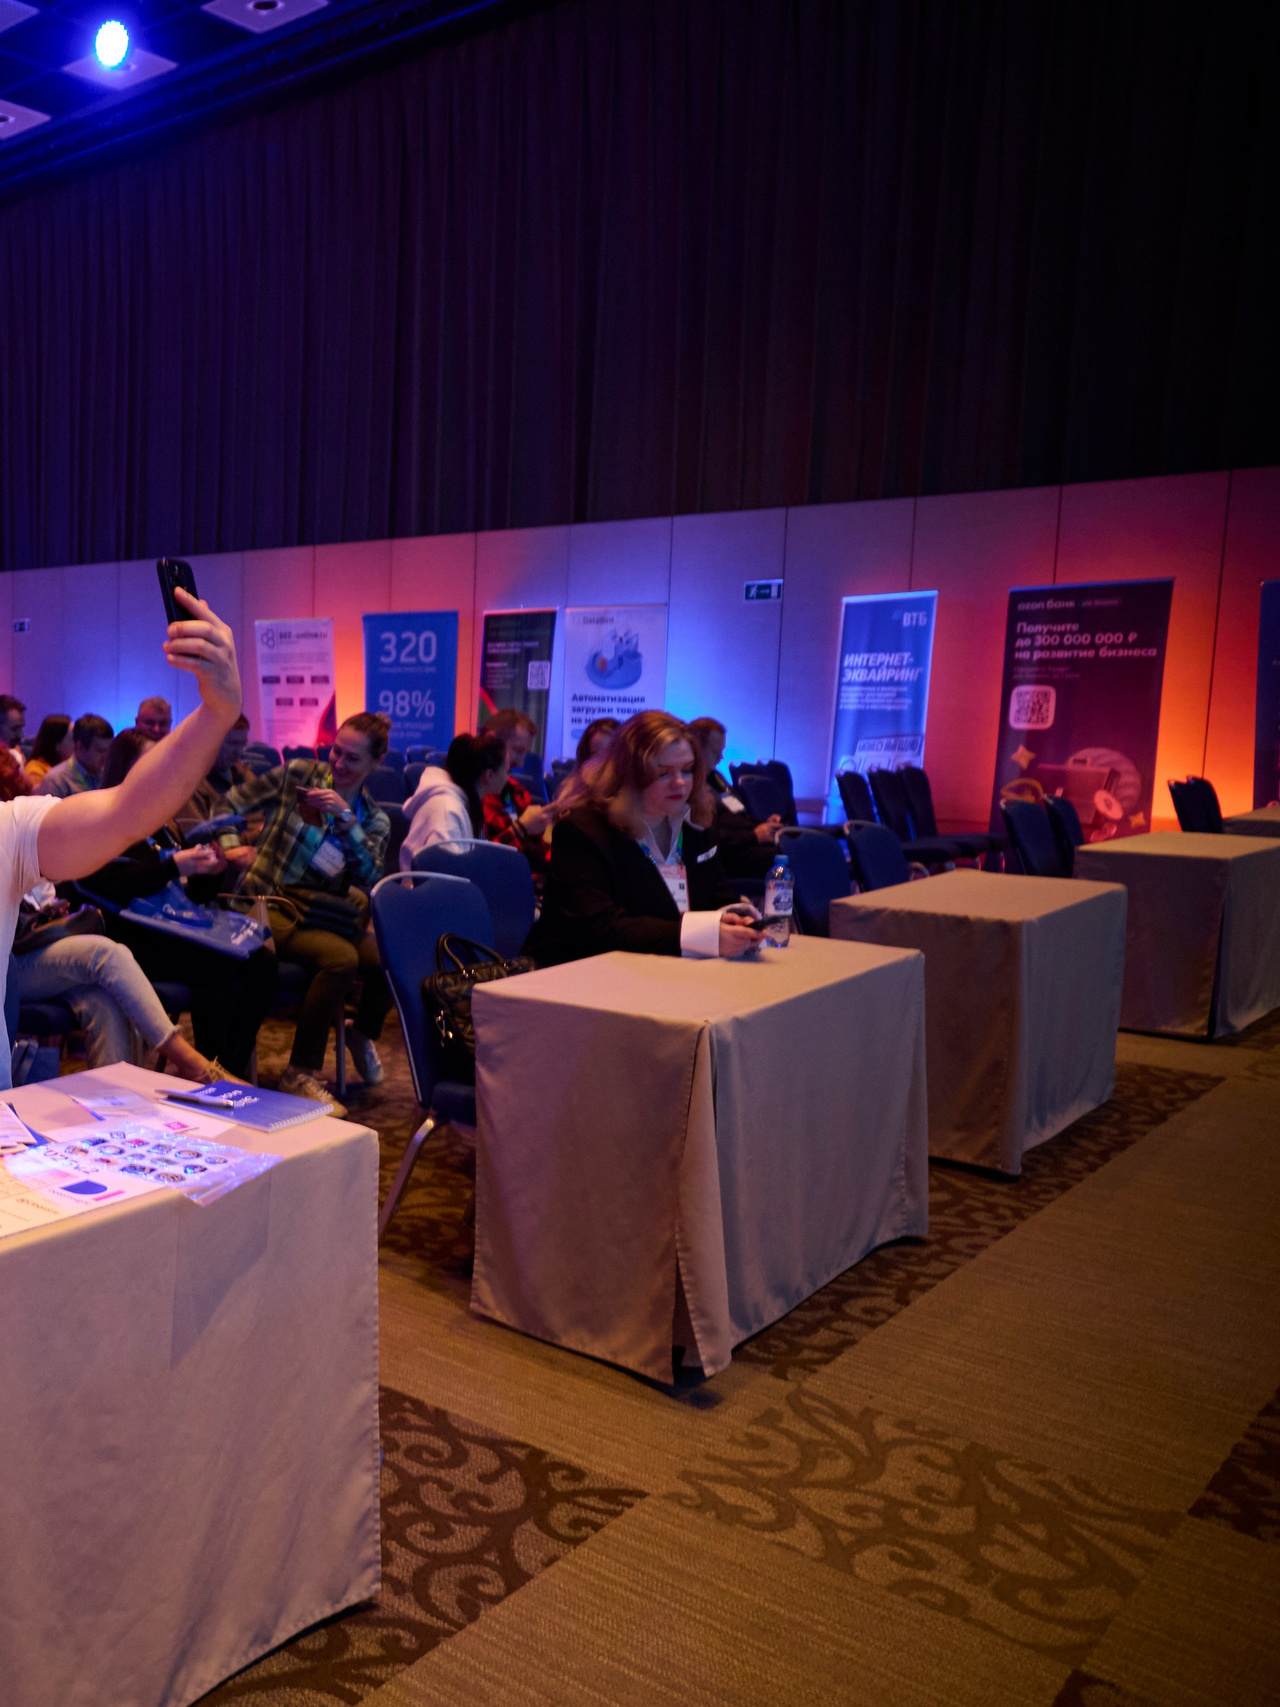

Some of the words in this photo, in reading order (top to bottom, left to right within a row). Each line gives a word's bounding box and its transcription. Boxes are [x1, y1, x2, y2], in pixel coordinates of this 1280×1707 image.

[1046, 598, 1075, 609] банк
[902, 611, 928, 627] ВТБ
[1016, 621, 1080, 634] Получите
[380, 629, 437, 664] 320
[1015, 637, 1032, 649] до
[1034, 634, 1060, 646] 300
[1063, 632, 1091, 645] 000
[1094, 631, 1124, 644] 000
[843, 652, 915, 667] ИНТЕРНЕТ-
[1014, 649, 1031, 660] на
[1032, 648, 1096, 661] развитие
[1098, 645, 1158, 658] бизнеса
[842, 666, 924, 682] ЭКВАЙРИНГ
[378, 689, 436, 719] 98%
[571, 693, 646, 703] Автоматизация
[572, 705, 614, 716] загрузки
